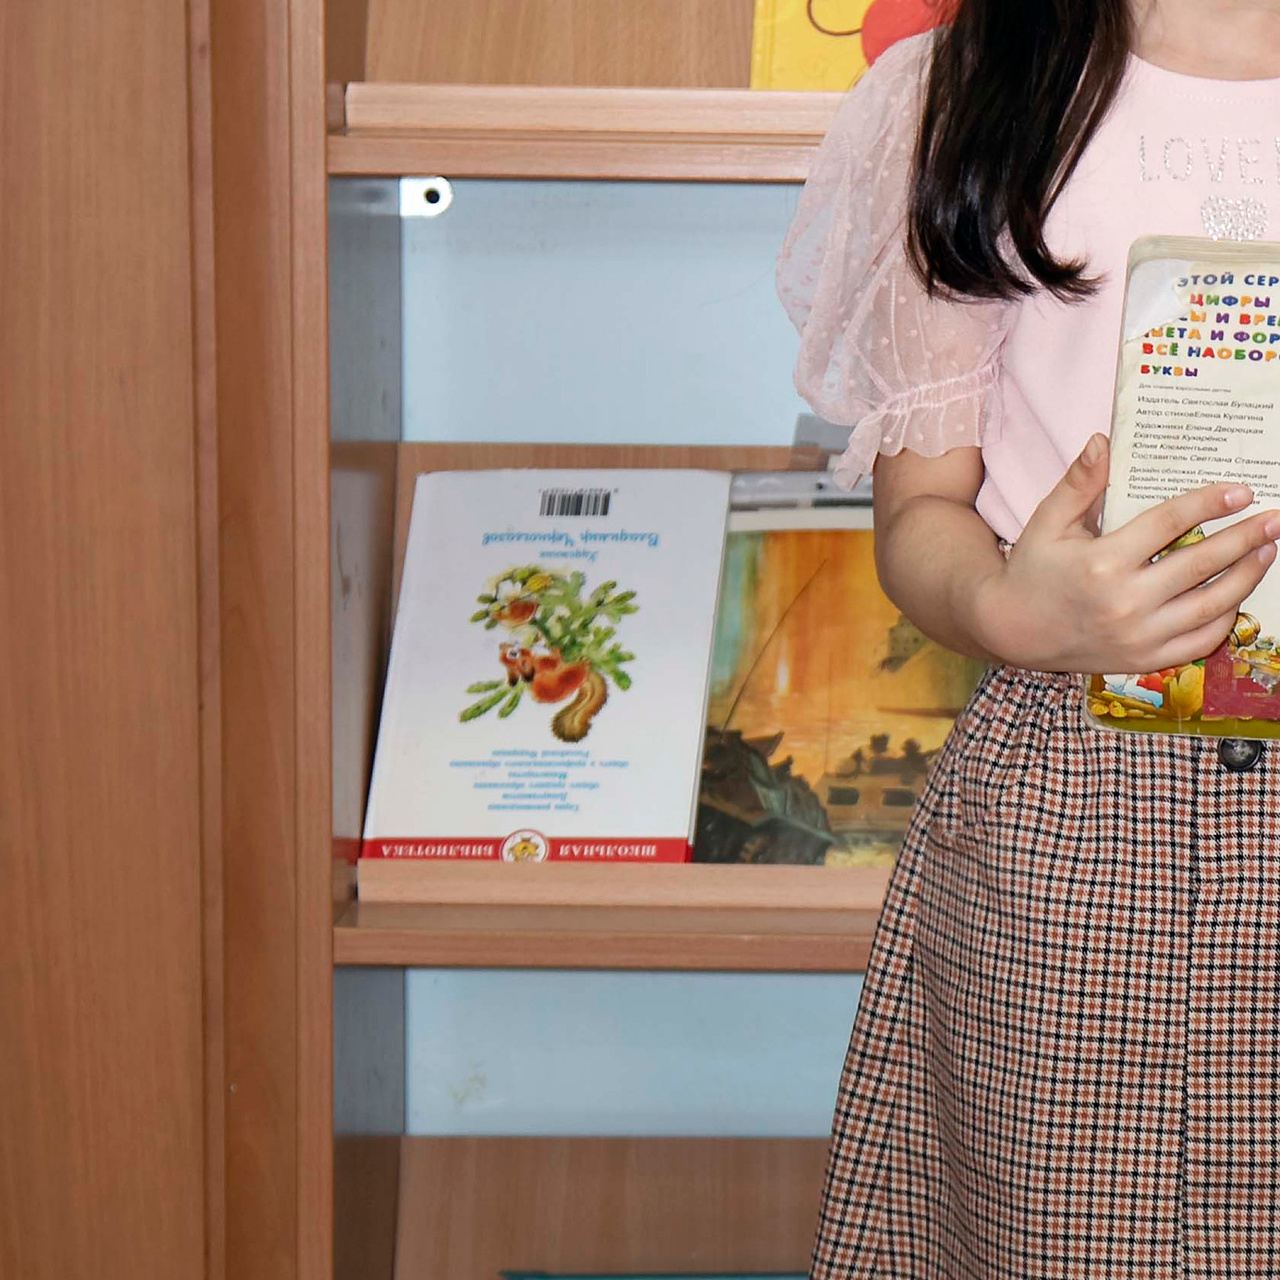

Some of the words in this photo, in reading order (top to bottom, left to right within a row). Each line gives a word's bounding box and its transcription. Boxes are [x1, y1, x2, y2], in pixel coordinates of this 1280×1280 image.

[1177, 272, 1234, 288] ЭТОЙ
[1189, 293, 1271, 308] ЦИФРЫ
[1215, 313, 1230, 324] И
[1210, 330, 1224, 341] И
[1142, 342, 1179, 356] ВСЁ
[1140, 364, 1198, 377] БУКВЫ
[1138, 395, 1180, 405] Издатель
[1136, 408, 1163, 416] Автор
[1135, 421, 1184, 430] Художники
[1185, 423, 1212, 431] Елена
[1131, 451, 1188, 461] Составитель
[1189, 454, 1233, 463] Светлана
[381, 843, 494, 857] БИБЛИОТЕКА
[559, 843, 656, 857] ШКОЛЬНАЯ
